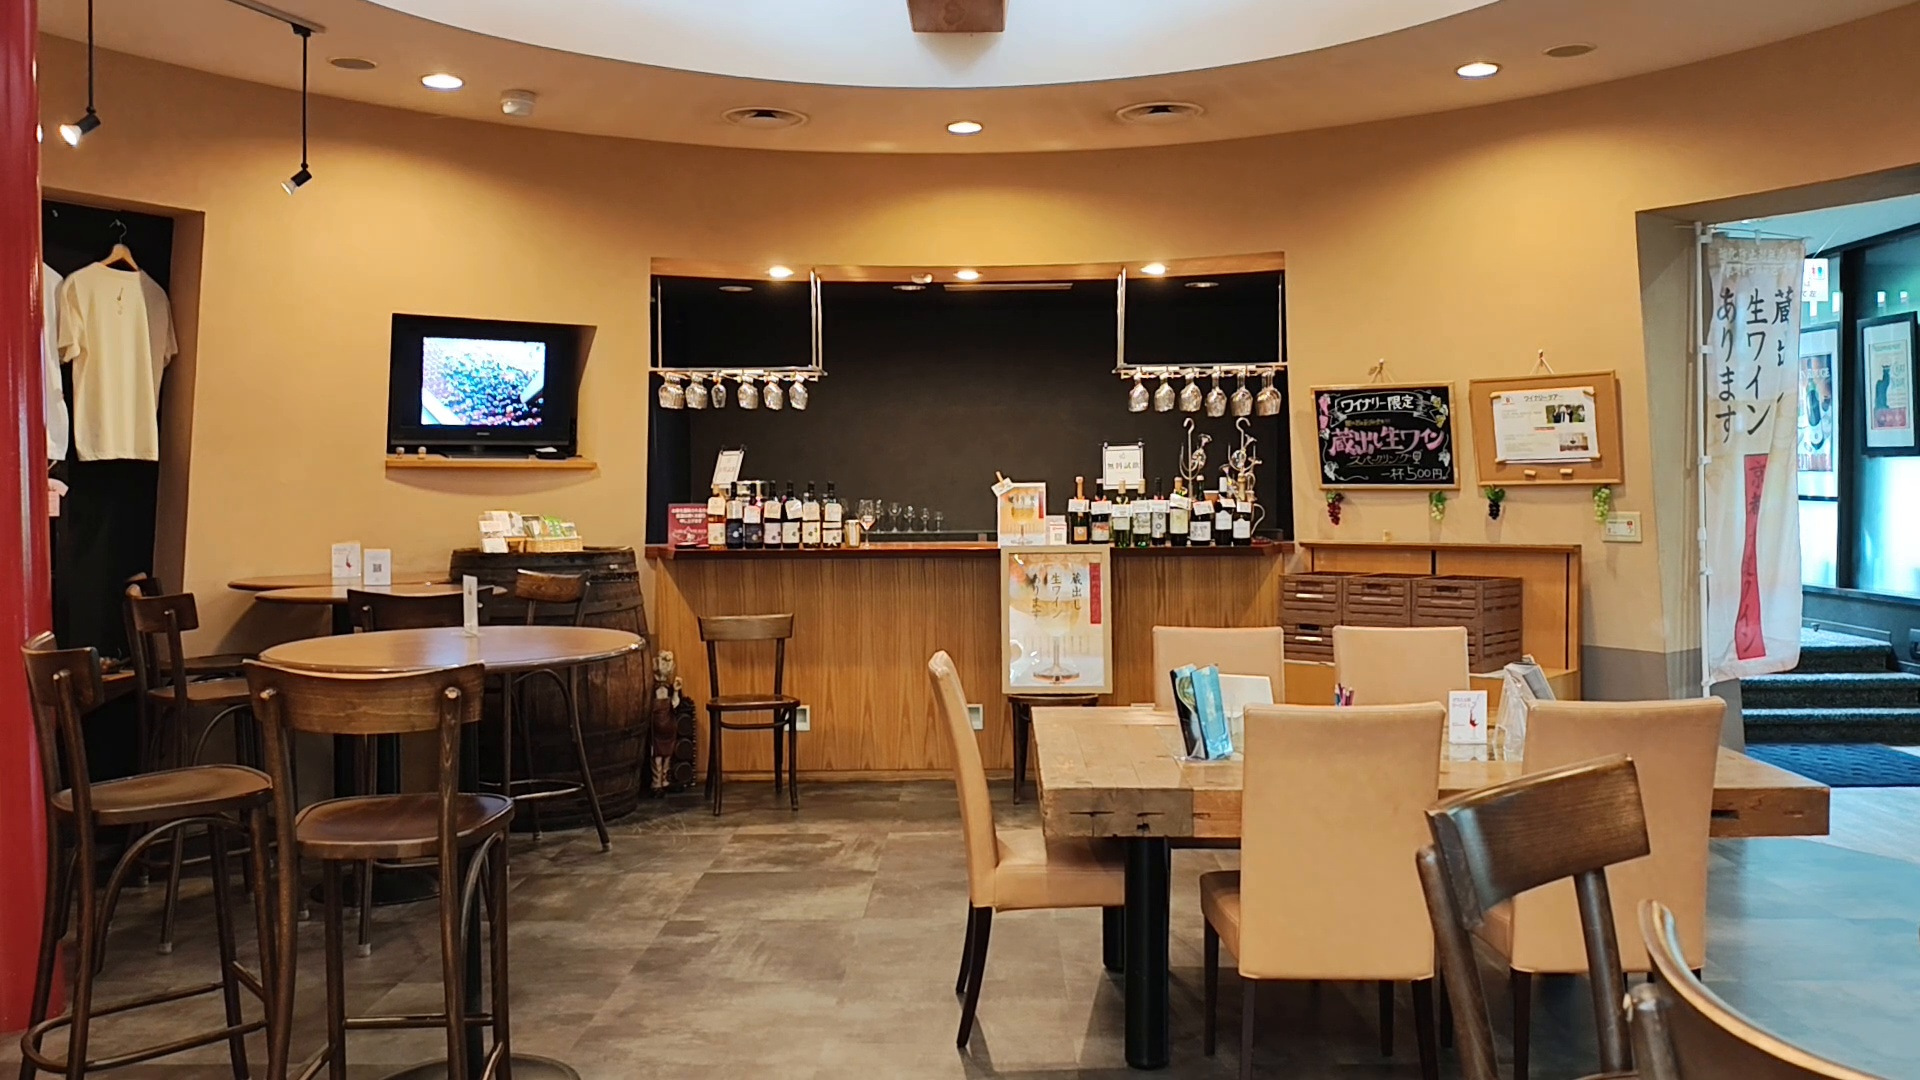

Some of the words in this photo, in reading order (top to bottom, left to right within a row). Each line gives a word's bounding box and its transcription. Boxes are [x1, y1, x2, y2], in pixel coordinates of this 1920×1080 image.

[1715, 287, 1737, 444] あります
[1745, 288, 1771, 436] 生ワイン
[1340, 394, 1415, 413] ワイナリー限定
[1328, 425, 1445, 457] 蔵出し生ワイン
[1051, 571, 1062, 619] 生ワイン
[1070, 571, 1083, 611] 蔵出し
